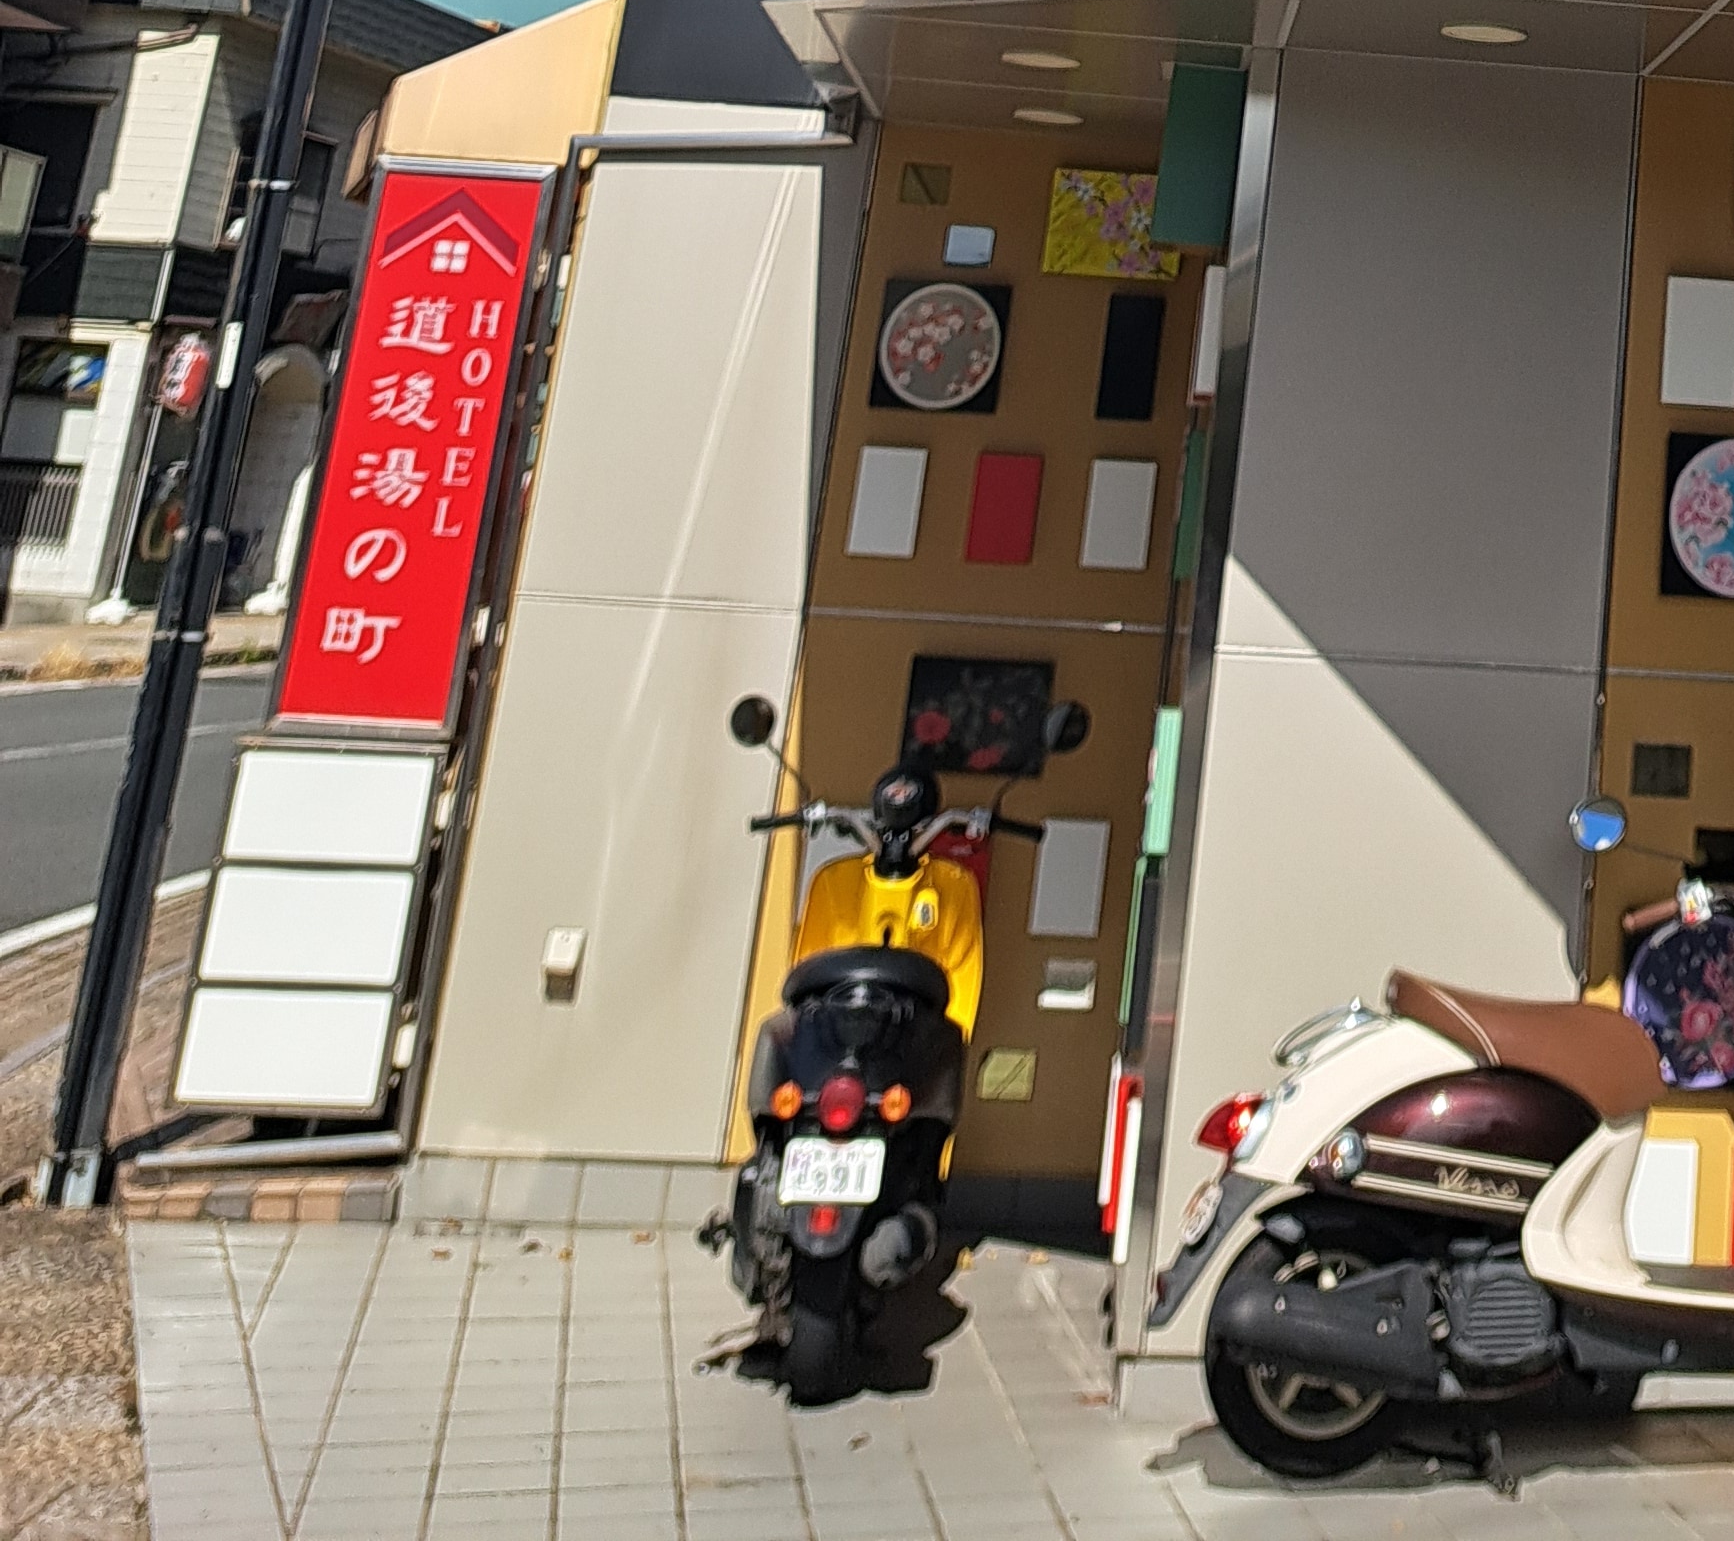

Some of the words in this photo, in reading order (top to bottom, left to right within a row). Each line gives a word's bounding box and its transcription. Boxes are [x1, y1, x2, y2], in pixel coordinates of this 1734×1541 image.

[319, 294, 458, 665] 道後湯の町
[430, 298, 505, 539] HOTEL
